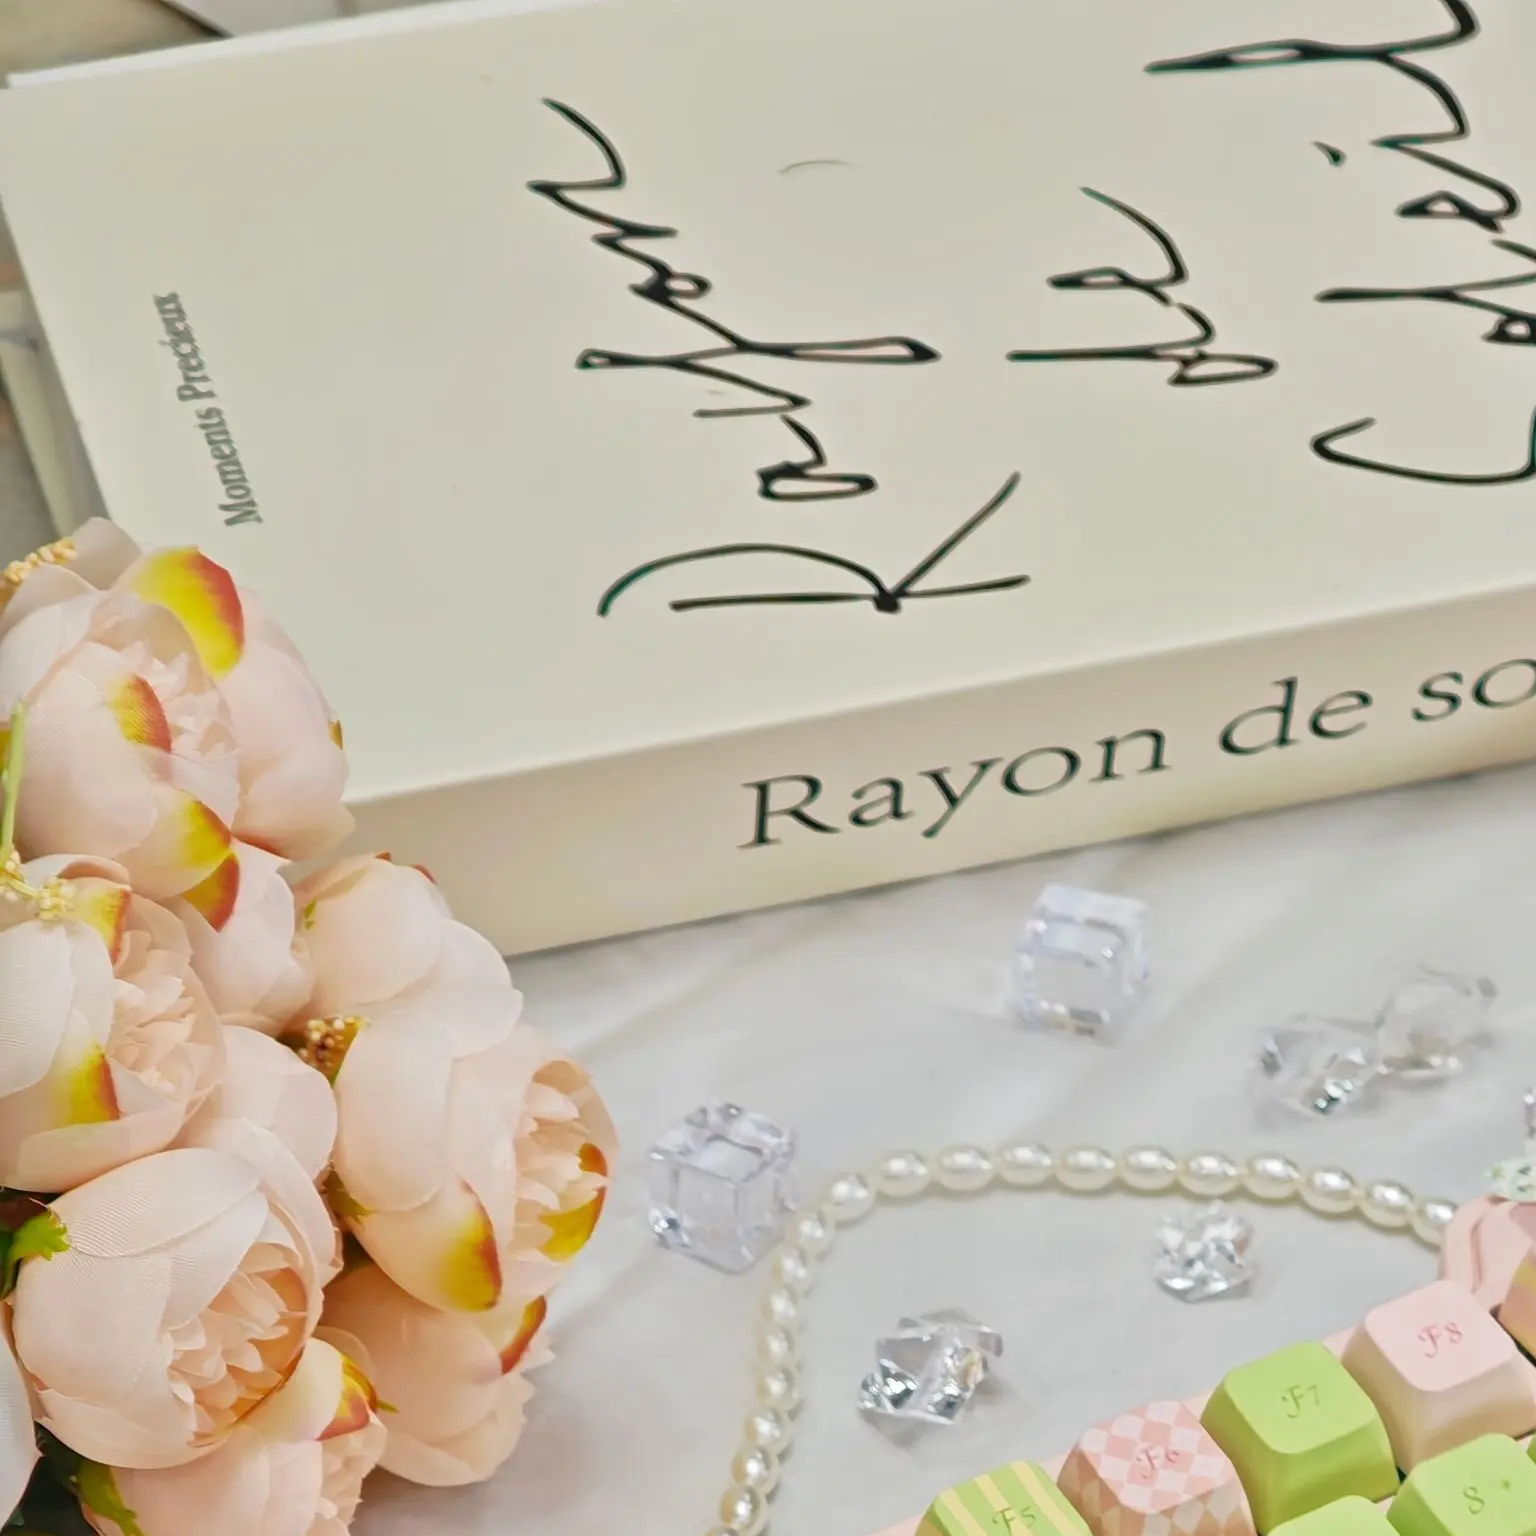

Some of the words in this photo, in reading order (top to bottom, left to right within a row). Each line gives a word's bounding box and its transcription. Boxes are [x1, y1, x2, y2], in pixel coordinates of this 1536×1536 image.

[152, 291, 214, 405] Precieux
[194, 408, 263, 528] Moments
[735, 728, 1170, 850] Rayon
[1217, 675, 1374, 757] de
[1416, 1321, 1464, 1359] F8
[1280, 1383, 1320, 1420] F7
